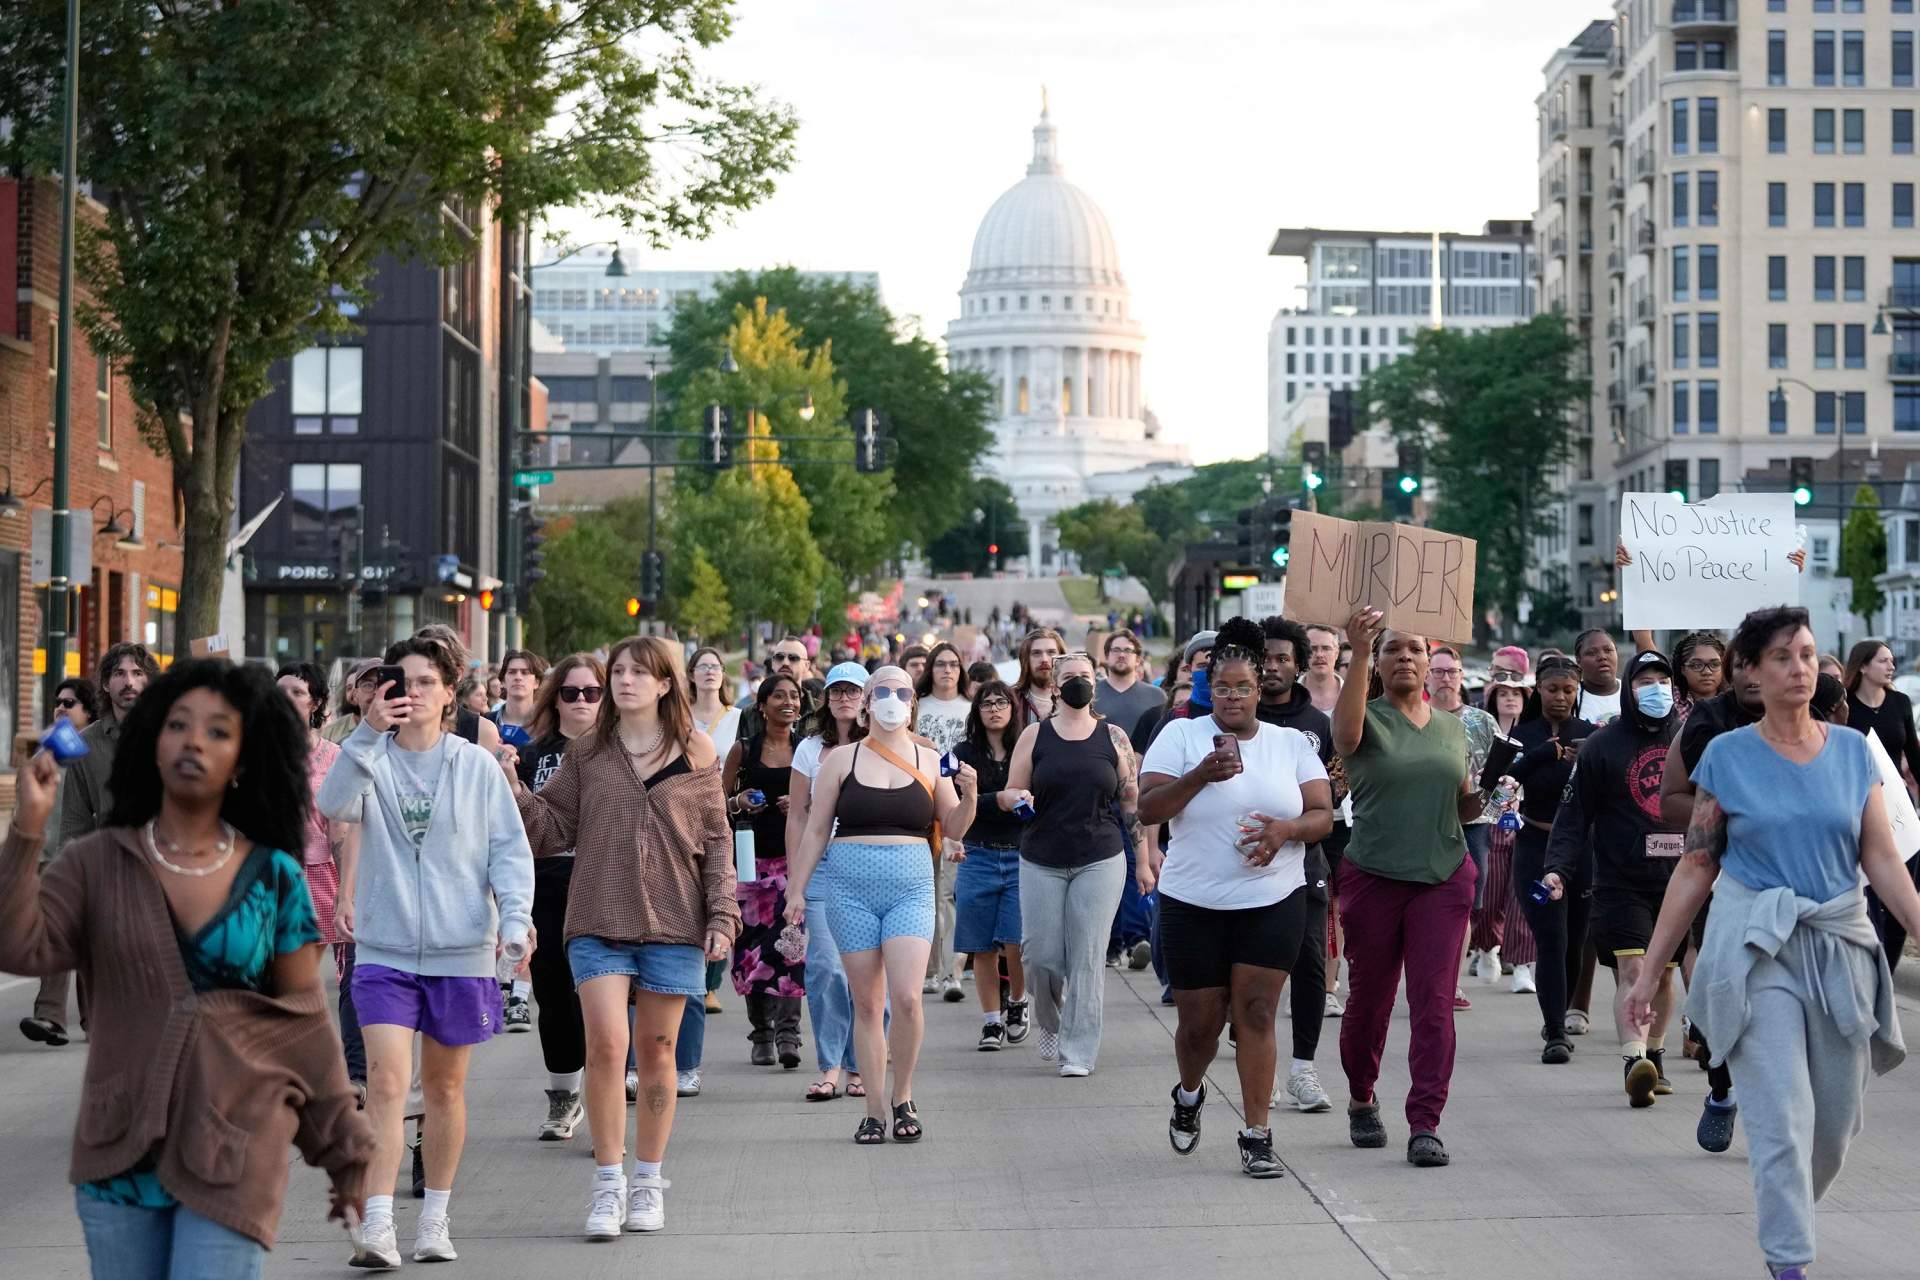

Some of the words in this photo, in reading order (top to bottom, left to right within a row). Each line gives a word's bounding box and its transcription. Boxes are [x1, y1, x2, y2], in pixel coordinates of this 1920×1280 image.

[1630, 499, 1677, 539] No
[1690, 506, 1773, 537] Justice
[1309, 527, 1468, 621] MURDER
[1639, 550, 1676, 584] No
